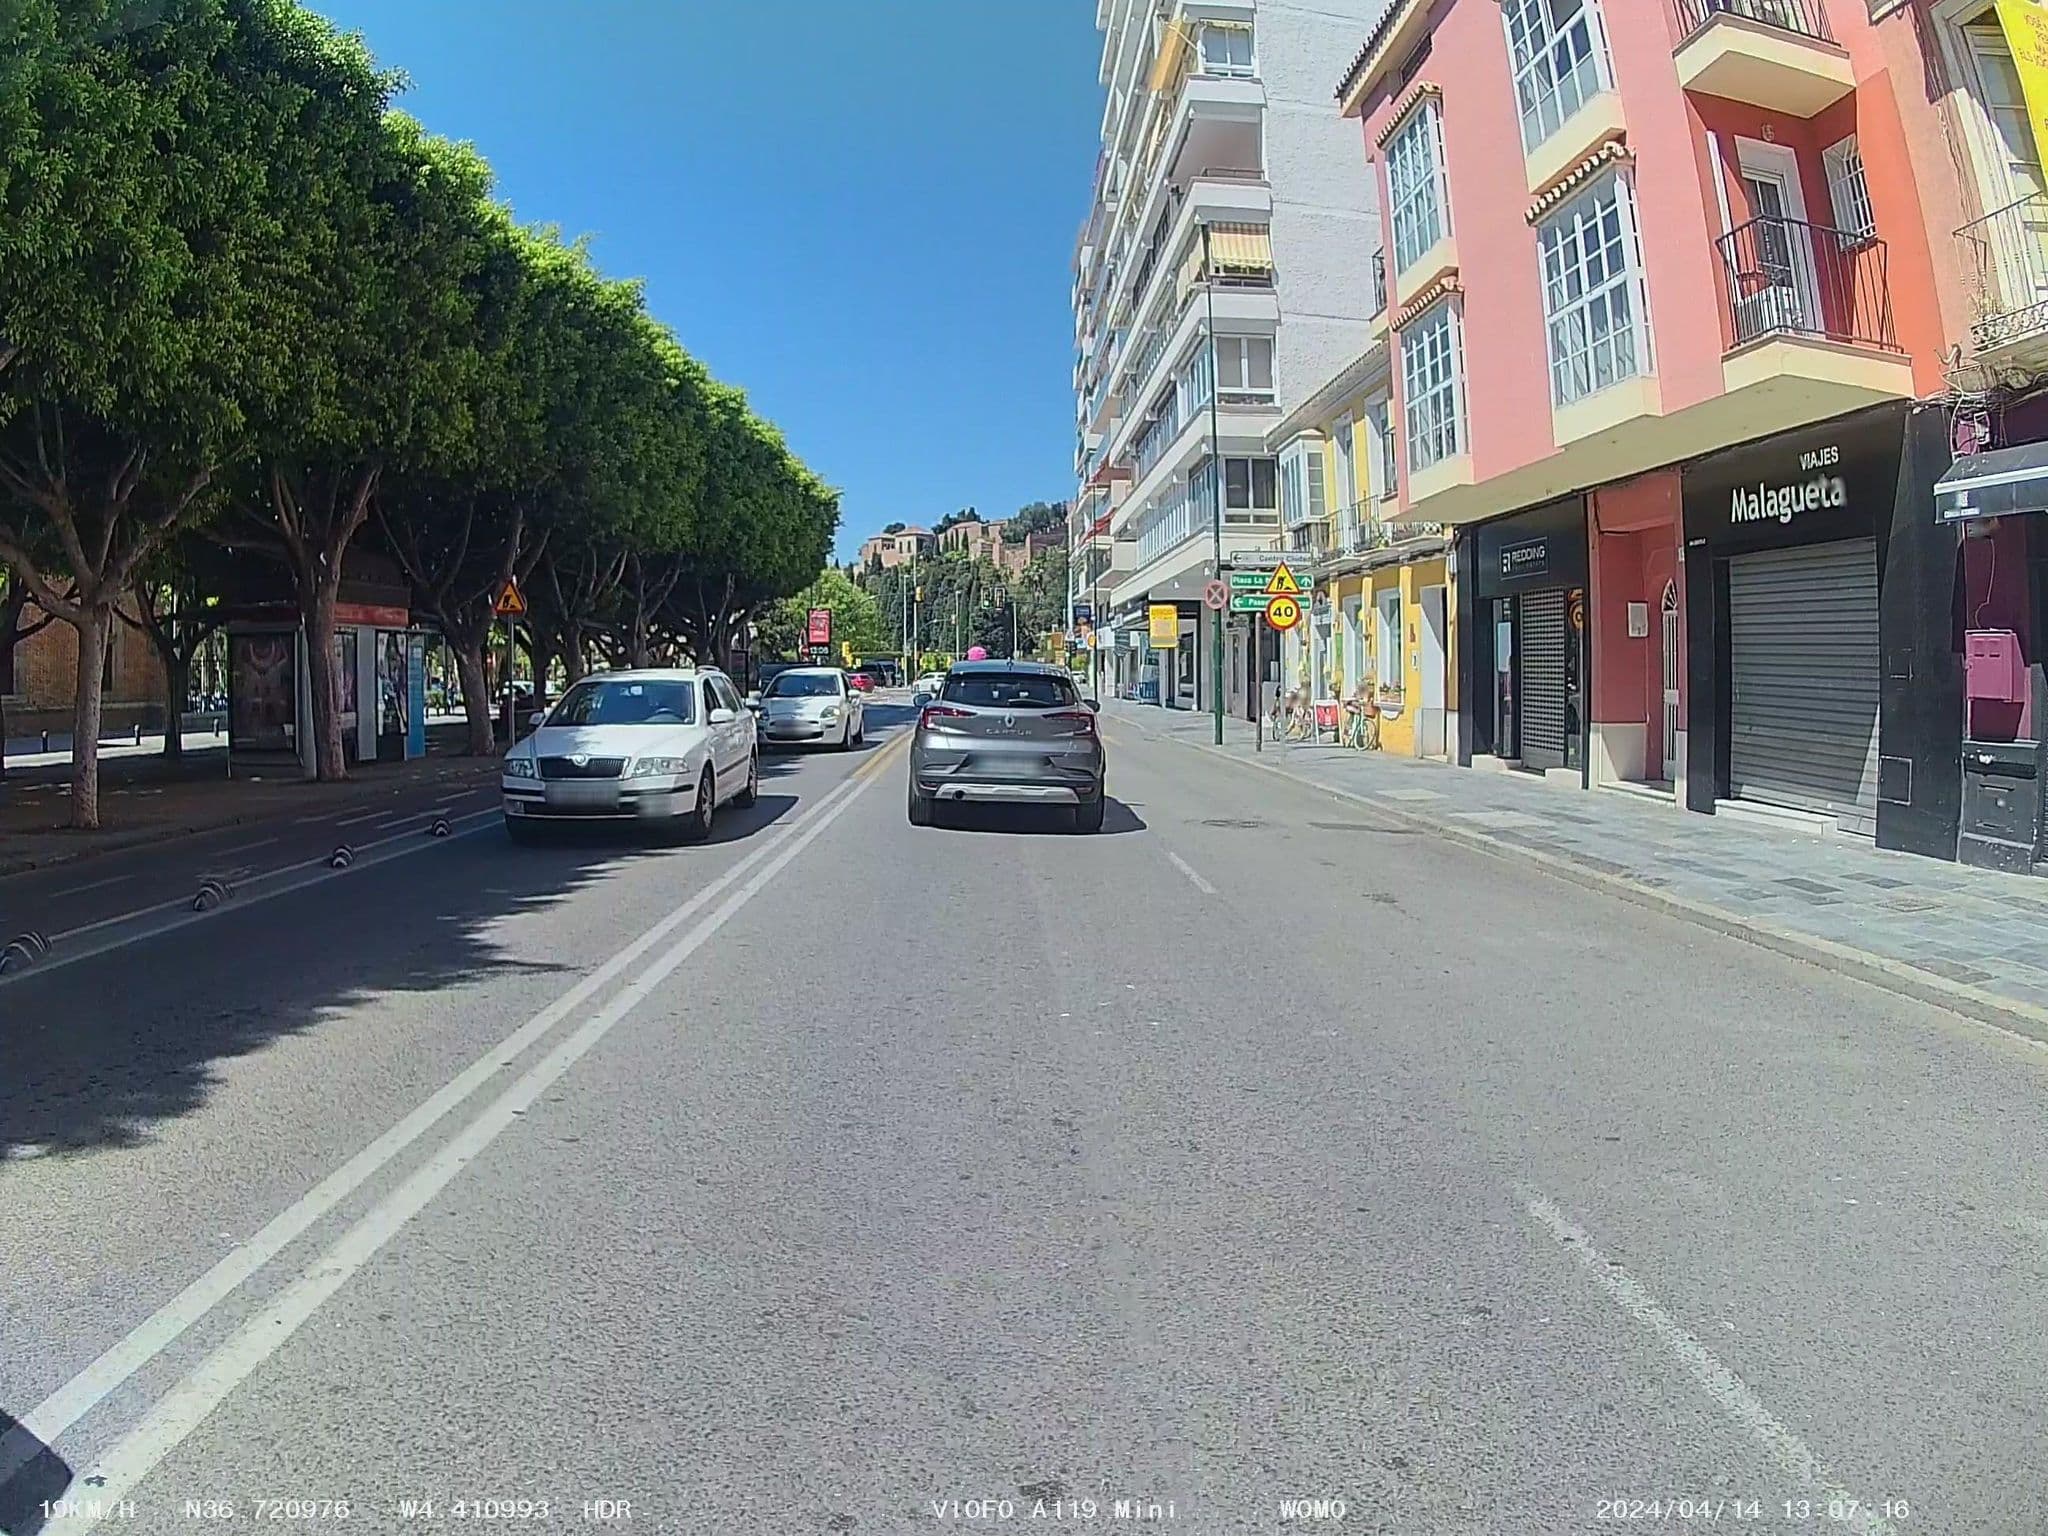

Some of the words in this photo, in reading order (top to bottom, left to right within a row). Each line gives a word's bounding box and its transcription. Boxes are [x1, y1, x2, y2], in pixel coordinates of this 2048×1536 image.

[1799, 446, 1839, 471] VIAJES
[1731, 474, 1847, 524] Malagueta
[1511, 544, 1546, 563] REDDING
[1273, 606, 1293, 618] 40
